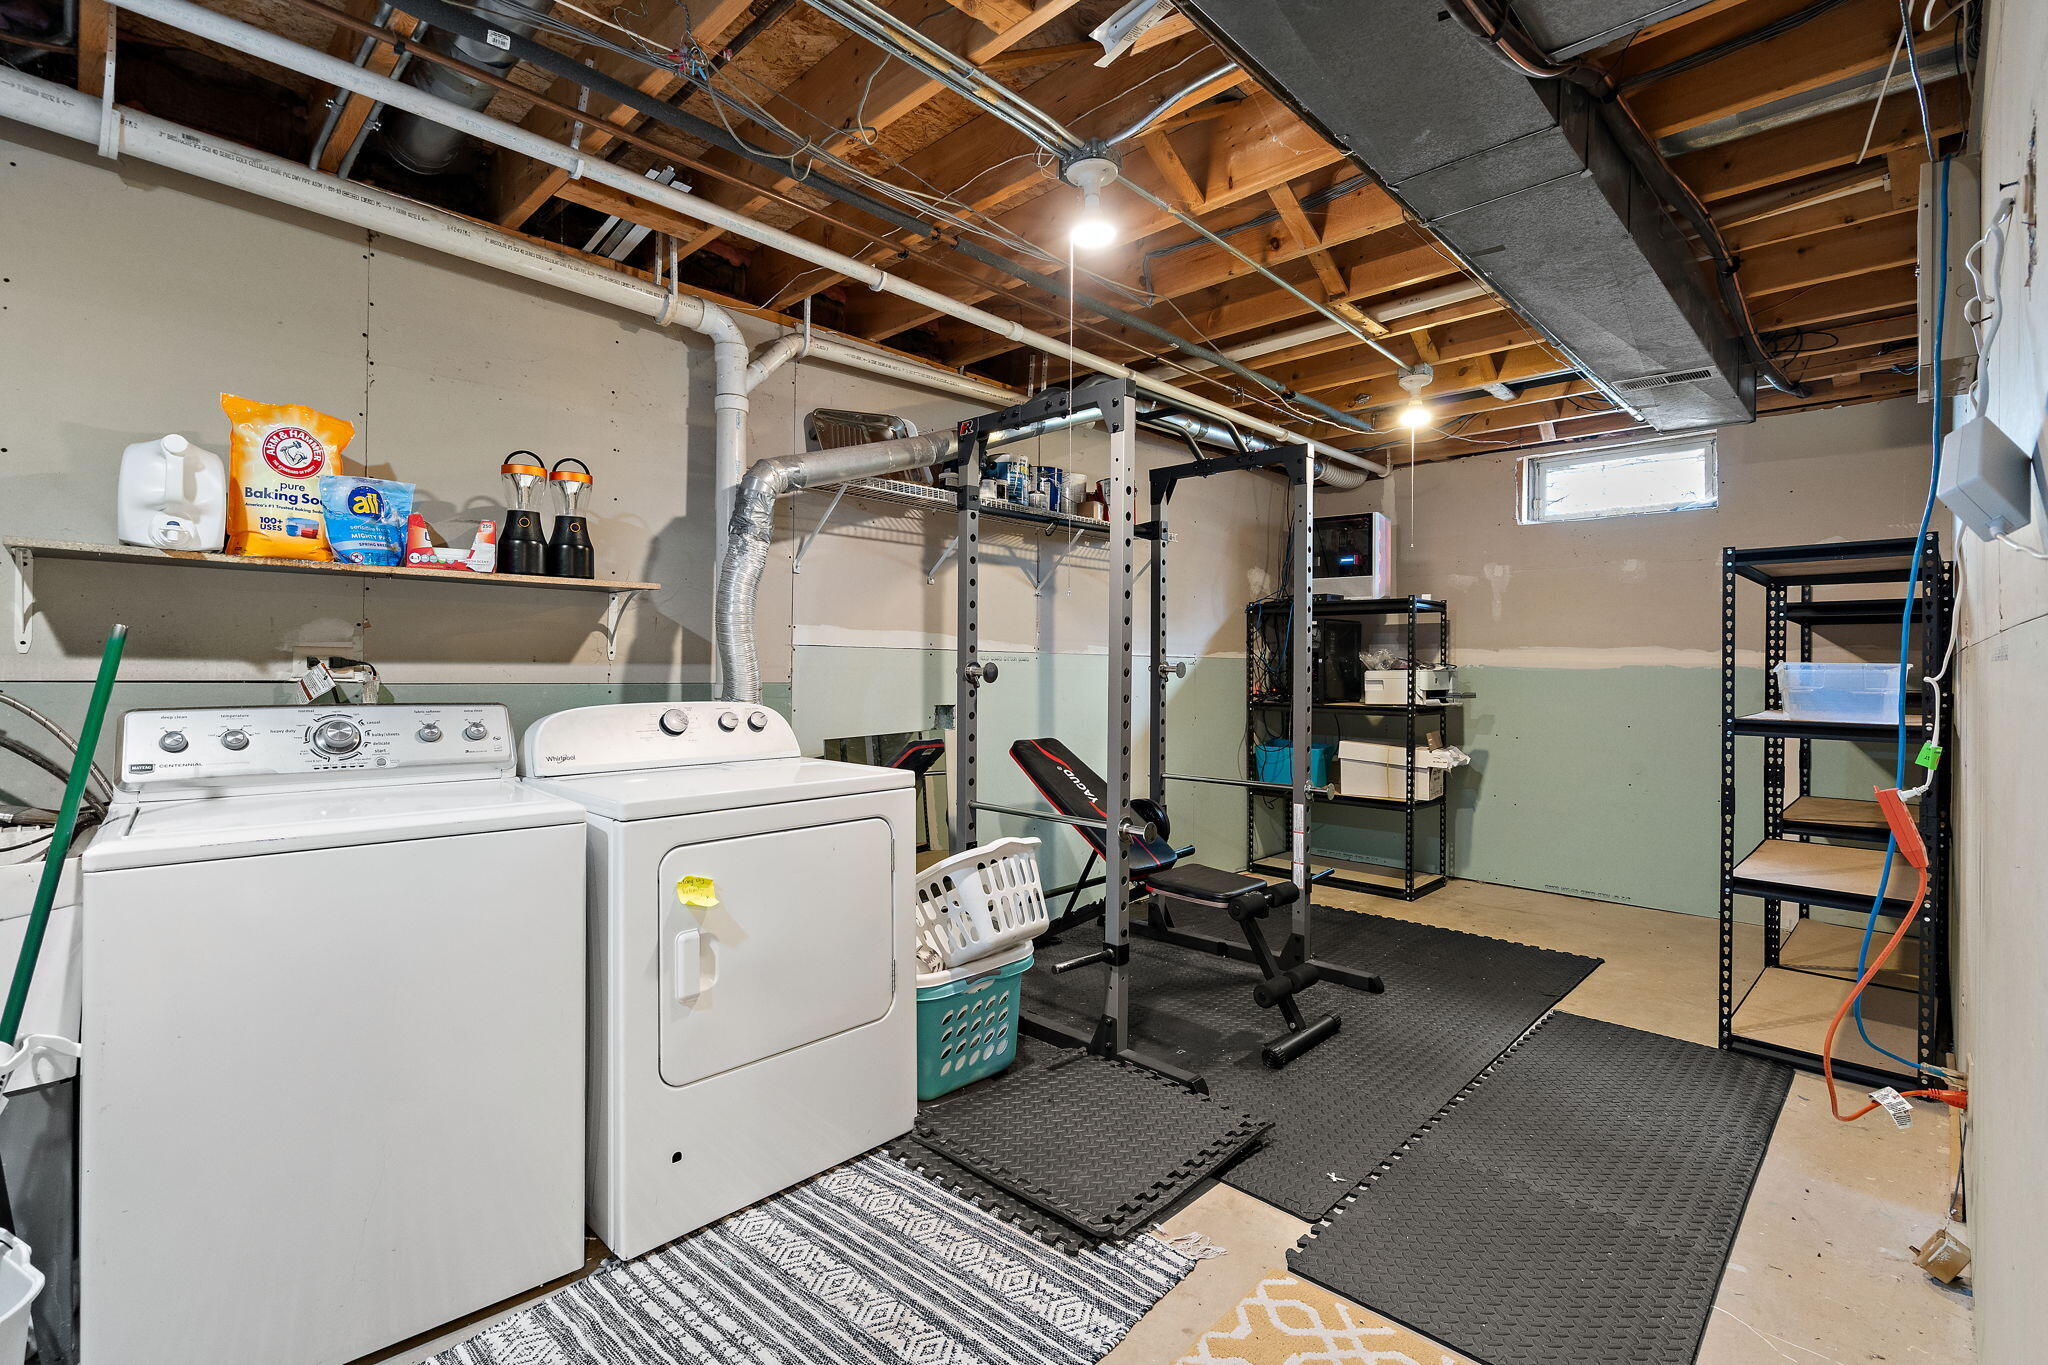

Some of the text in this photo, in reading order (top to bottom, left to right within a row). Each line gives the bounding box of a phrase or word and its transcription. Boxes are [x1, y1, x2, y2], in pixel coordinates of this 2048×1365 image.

[265, 435, 282, 456] ARM
[289, 429, 322, 462] HAMMER
[280, 482, 306, 492] pure
[244, 486, 325, 509] Baking So
[353, 493, 379, 514] all
[259, 516, 283, 525] 100+
[259, 523, 283, 532] USES
[545, 755, 576, 764] Whirlpool
[159, 761, 204, 769] CENTENNIAL
[1063, 768, 1099, 803] YAGUD
